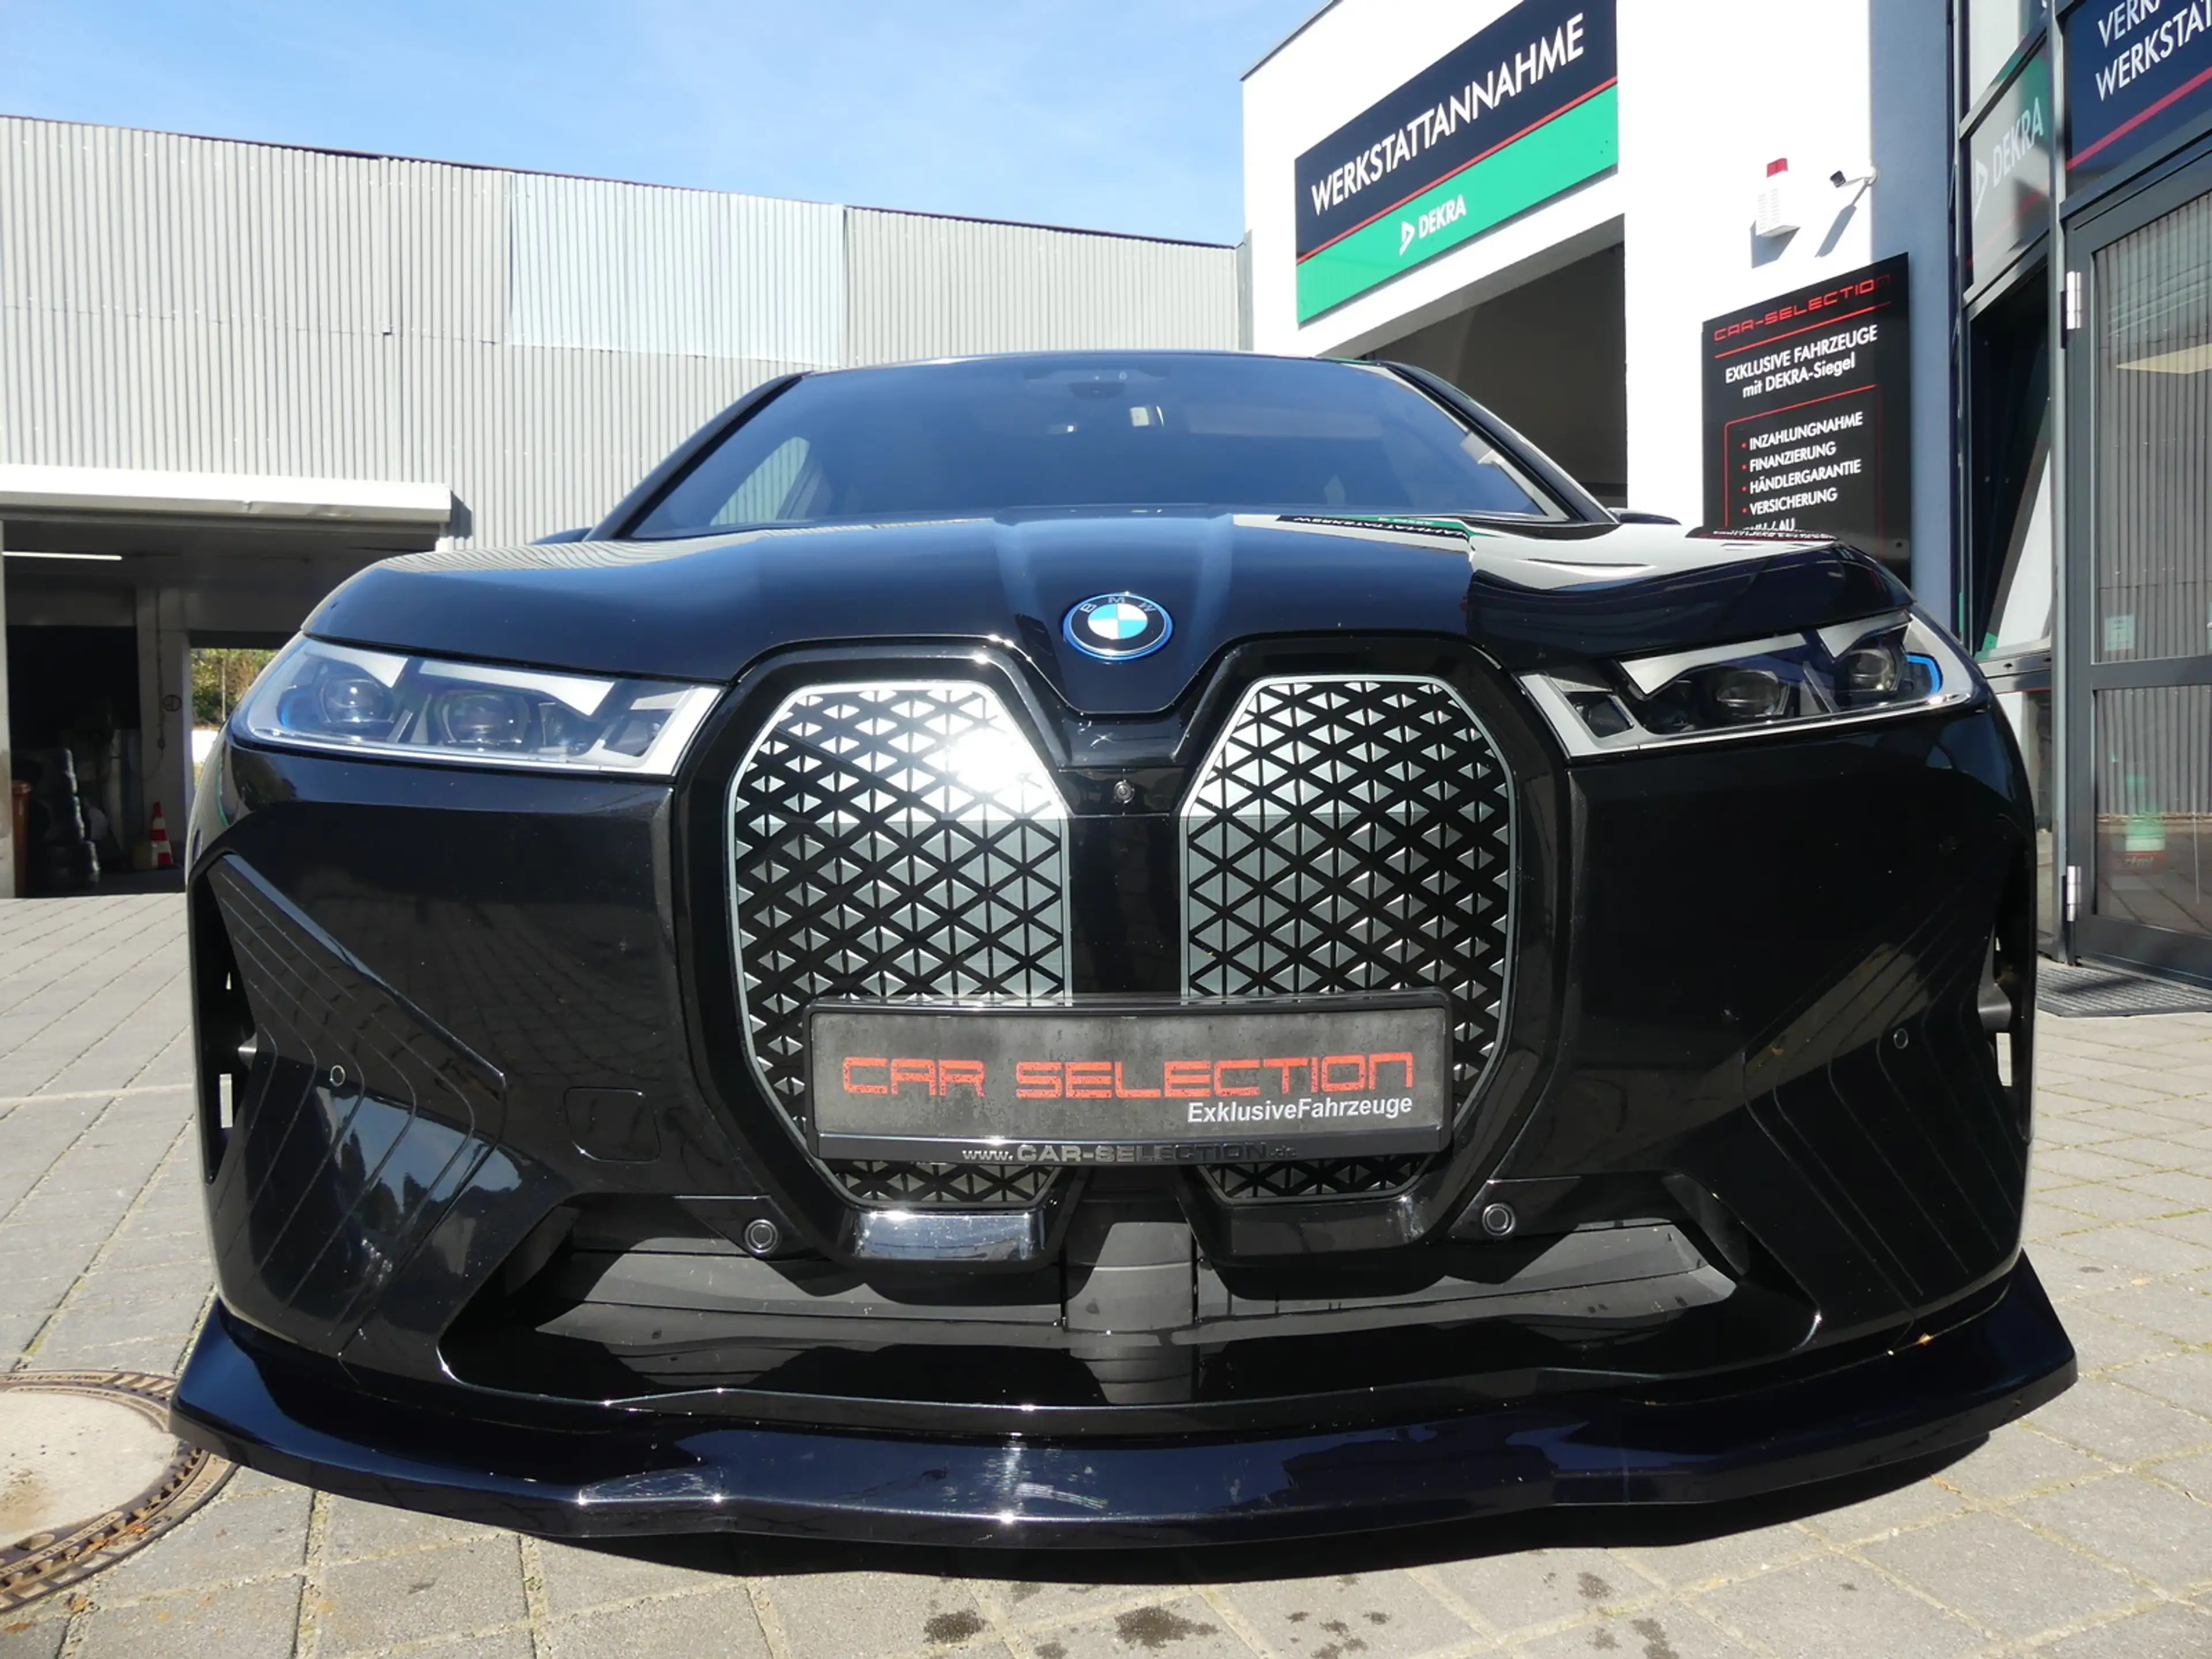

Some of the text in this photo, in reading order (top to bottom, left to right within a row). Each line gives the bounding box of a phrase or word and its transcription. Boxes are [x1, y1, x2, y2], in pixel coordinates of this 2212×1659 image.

[1310, 13, 1584, 216] WERKSTATTANNAHME
[1993, 97, 2044, 188] DEKRA
[1418, 194, 1467, 239] DEKRA
[1725, 324, 1878, 384] EXKLUSIVE FAHRZEUGE
[1743, 352, 1855, 398] mit DEKRA-Siegel
[1749, 411, 1863, 450] INZAHLUNGNAHME
[1749, 441, 1836, 472] FINANZIERUNG
[1749, 459, 1862, 494] HÄNDLERGARANTIE
[1749, 487, 1838, 516] VERSICHERUNG
[1080, 597, 1156, 613] BMW
[843, 1051, 1414, 1099] CAR SELECTION
[1187, 1097, 1413, 1123] ExklusiveFahrzeuge
